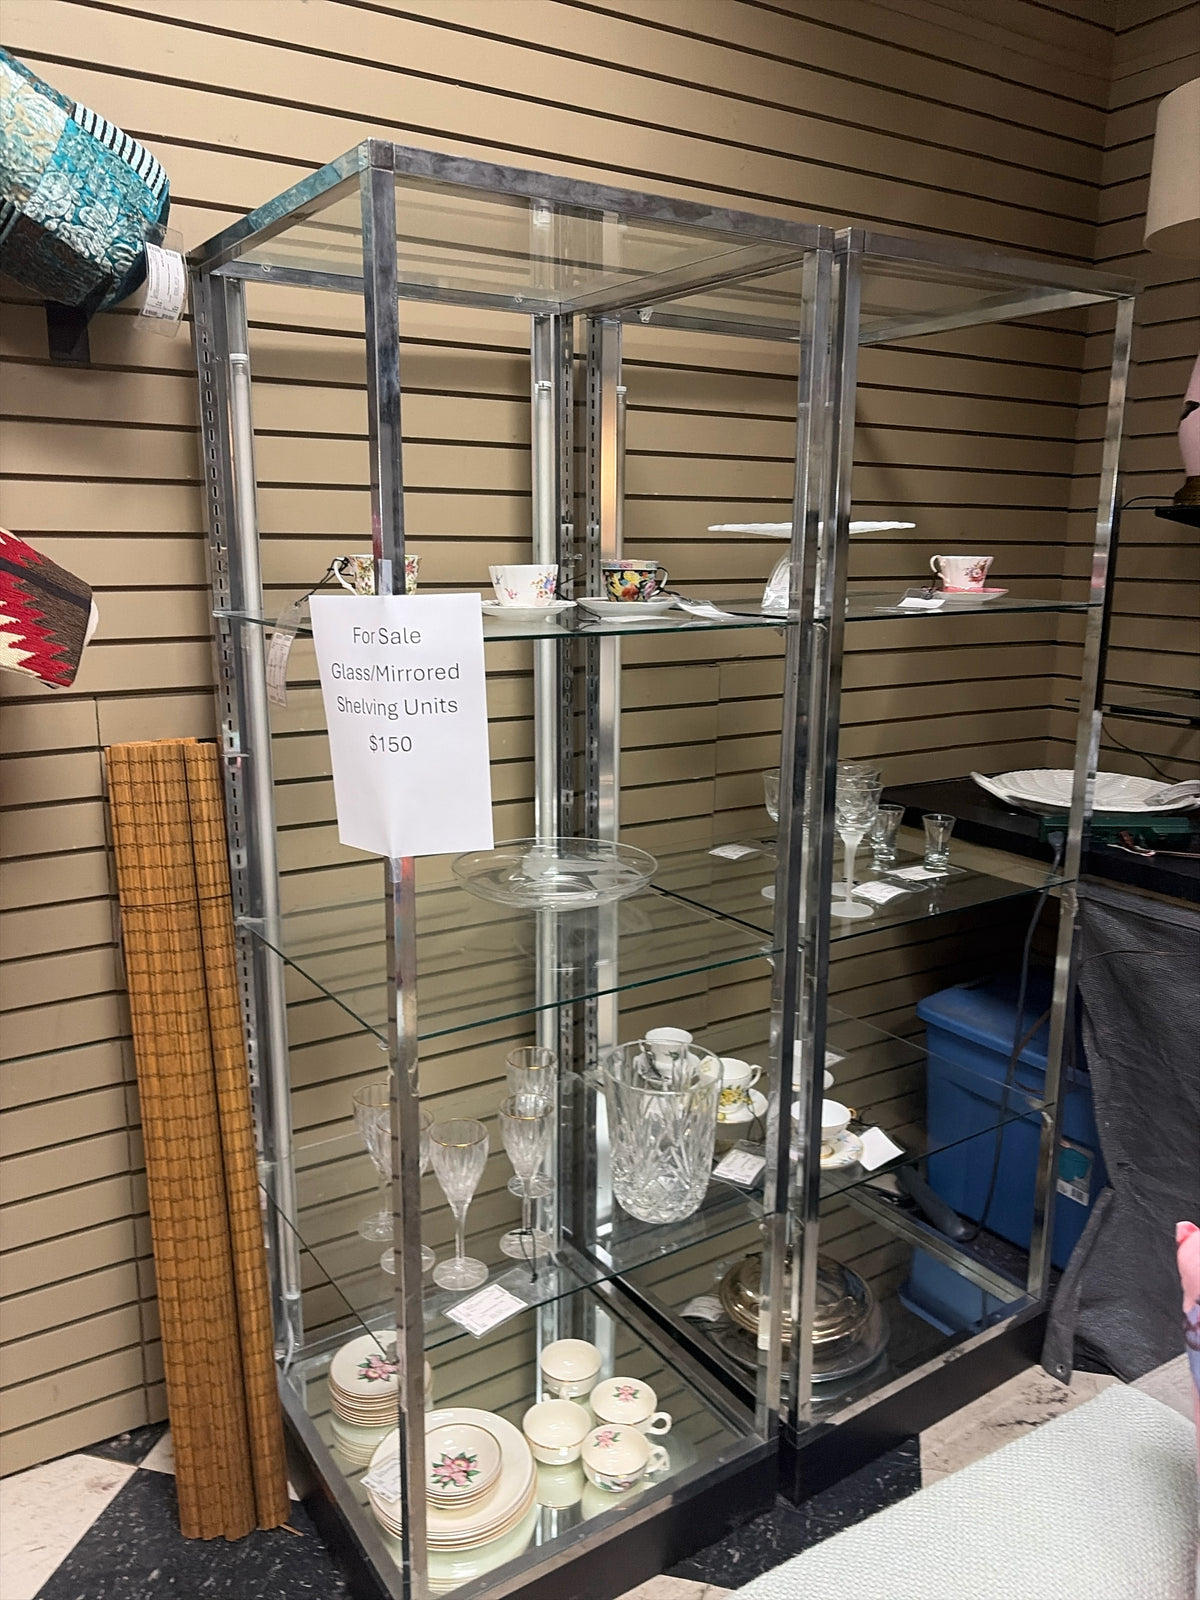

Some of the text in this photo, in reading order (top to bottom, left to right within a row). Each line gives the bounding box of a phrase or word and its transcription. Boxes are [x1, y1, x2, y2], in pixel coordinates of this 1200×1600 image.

[353, 627, 422, 645] For Sale
[331, 662, 460, 682] Glass/Mirrored
[337, 695, 458, 720] Shelving Units
[369, 733, 412, 753] $150
